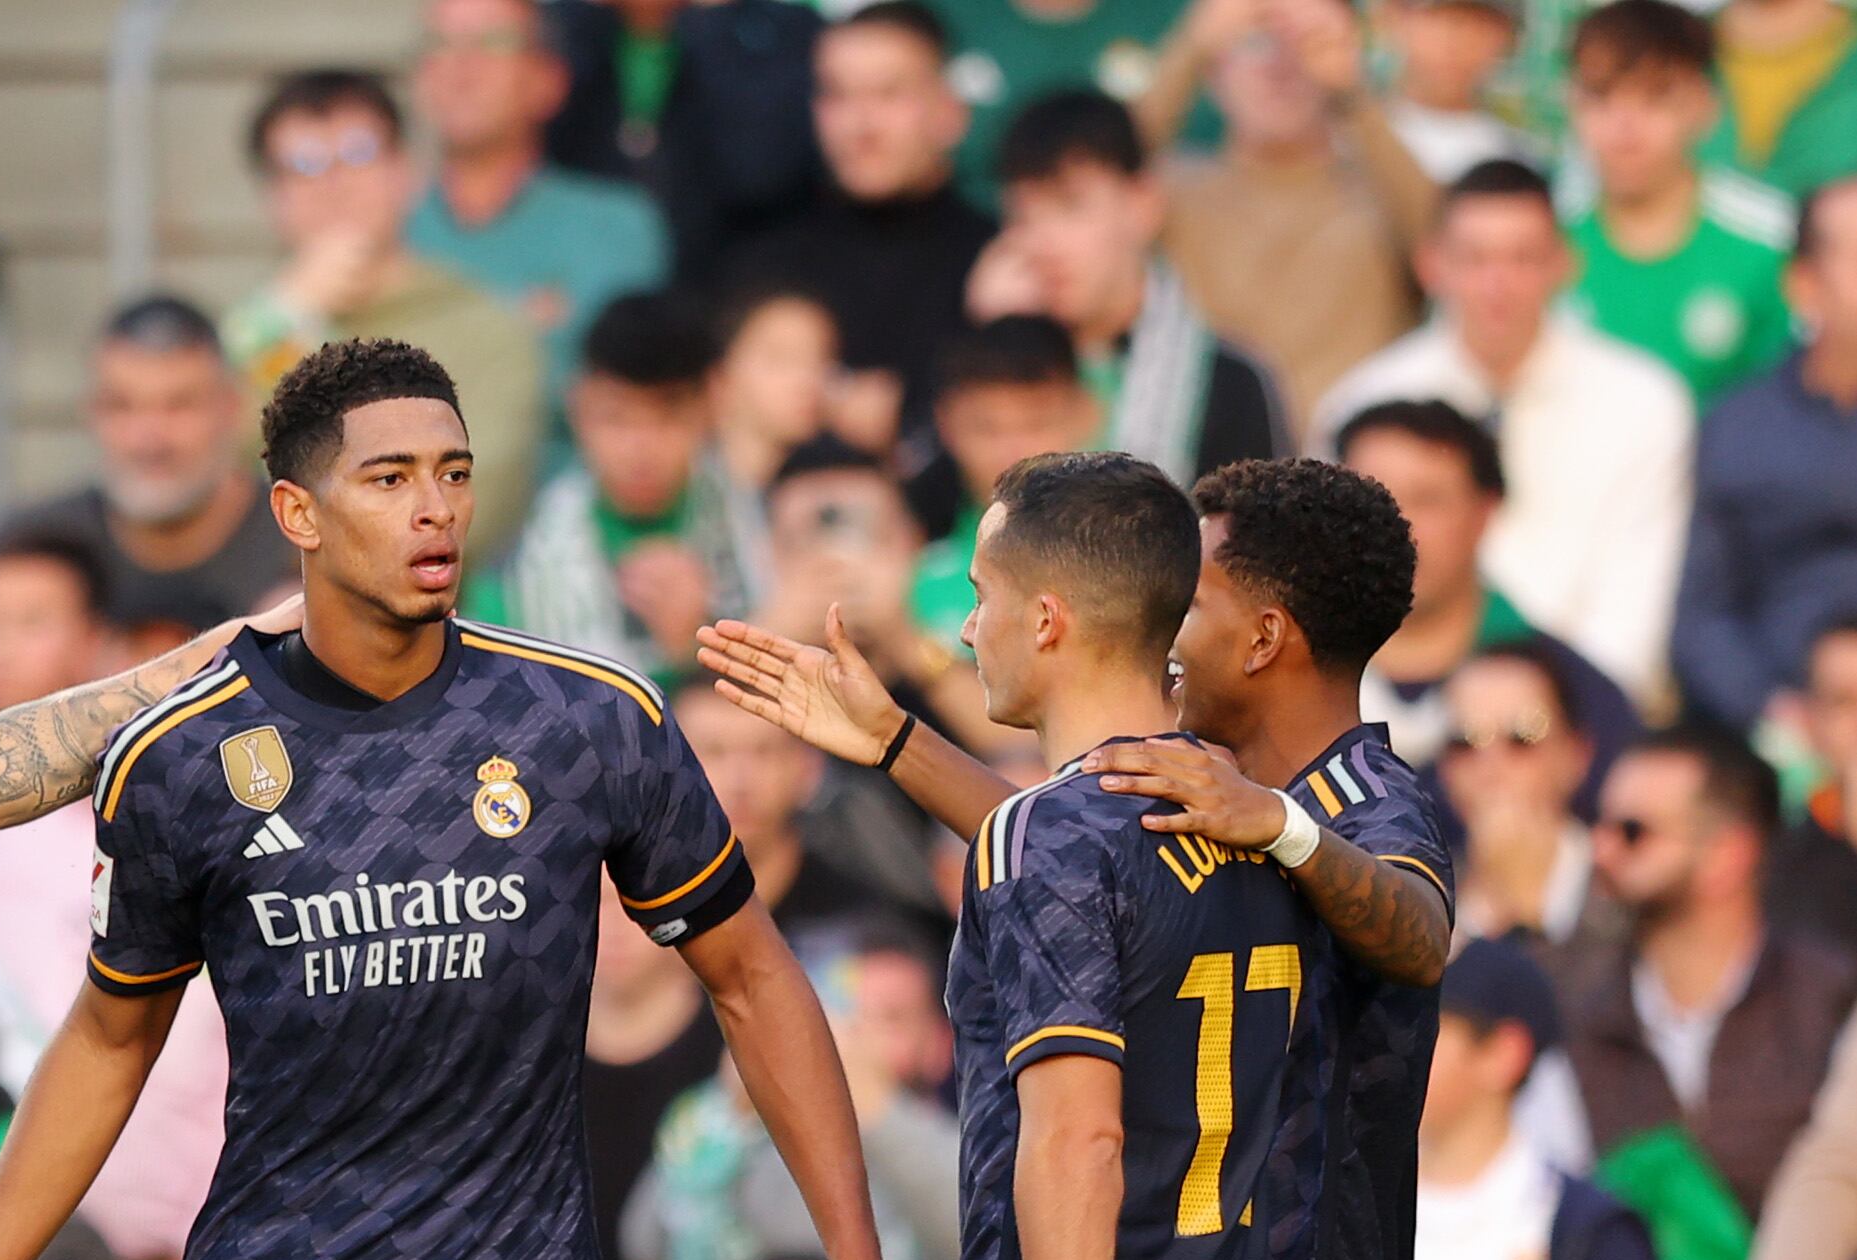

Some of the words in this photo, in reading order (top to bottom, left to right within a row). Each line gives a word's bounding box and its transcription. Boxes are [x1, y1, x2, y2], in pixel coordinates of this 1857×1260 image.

[249, 777, 278, 794] FIFA
[246, 868, 527, 947] Emirates
[304, 944, 357, 997] FLY
[363, 932, 486, 988] BETTER
